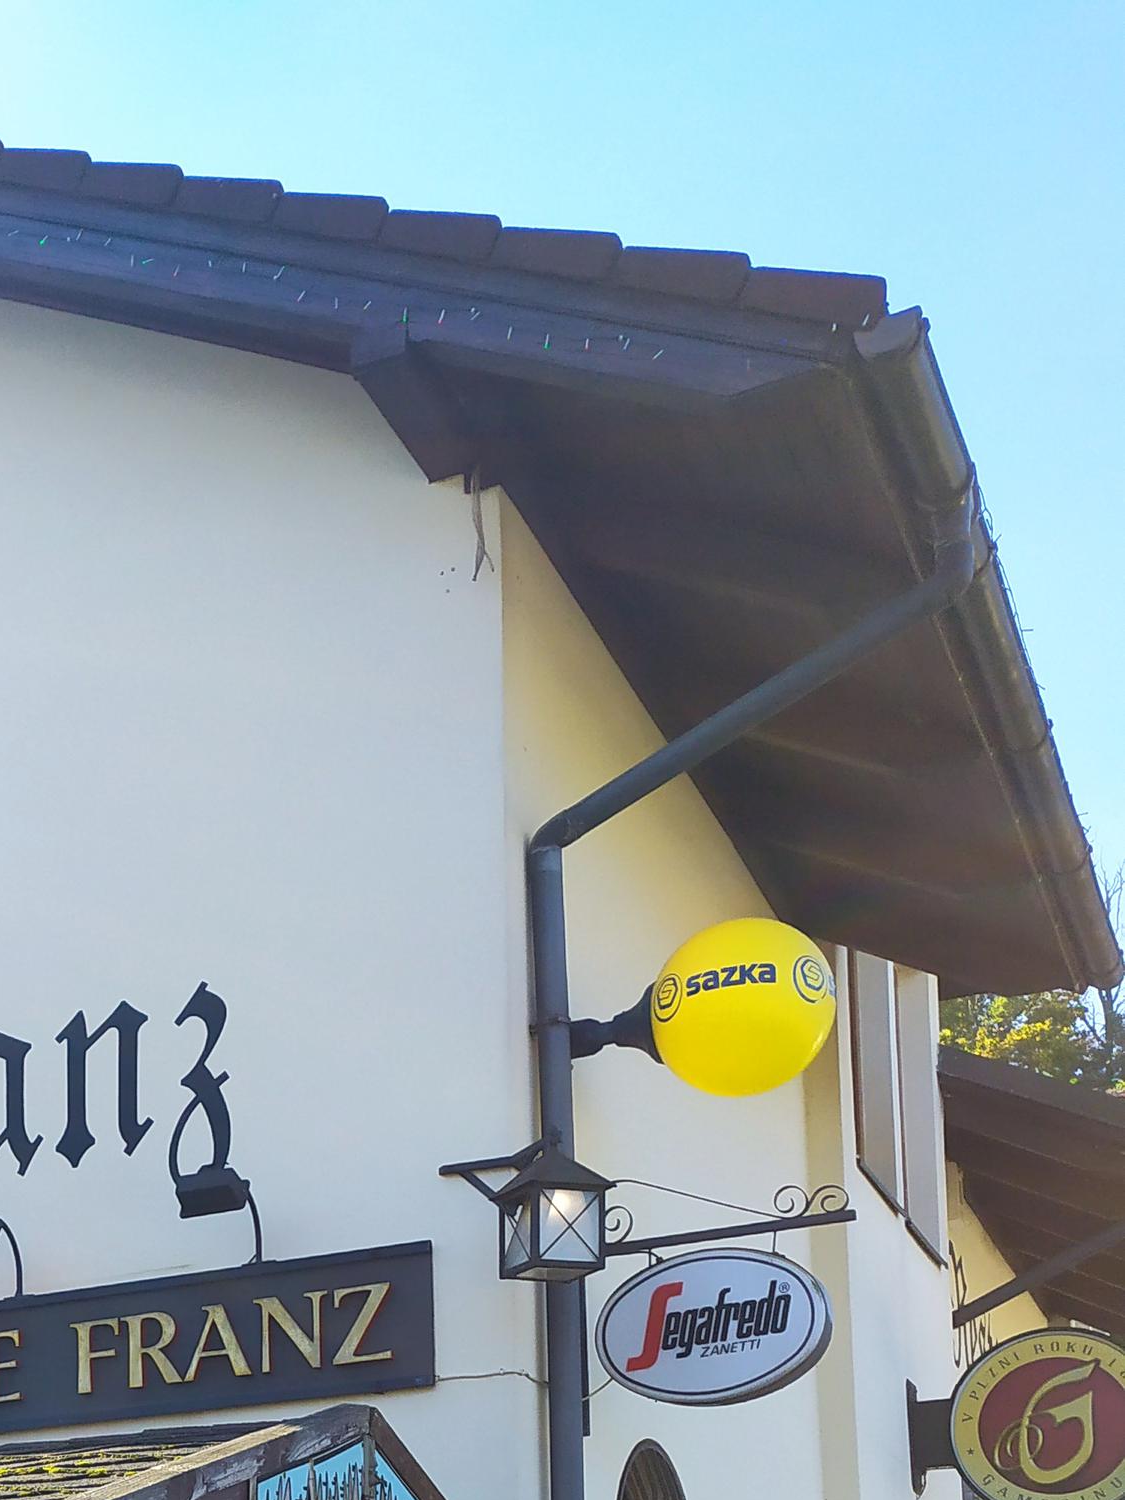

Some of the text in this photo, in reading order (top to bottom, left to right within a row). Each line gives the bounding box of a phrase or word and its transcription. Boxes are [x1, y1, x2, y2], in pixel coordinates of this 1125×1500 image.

[70, 1282, 394, 1395] FRANZ
[700, 1338, 761, 1358] ZANETTI
[962, 1412, 974, 1423] V
[1033, 1341, 1094, 1356] ROKU
